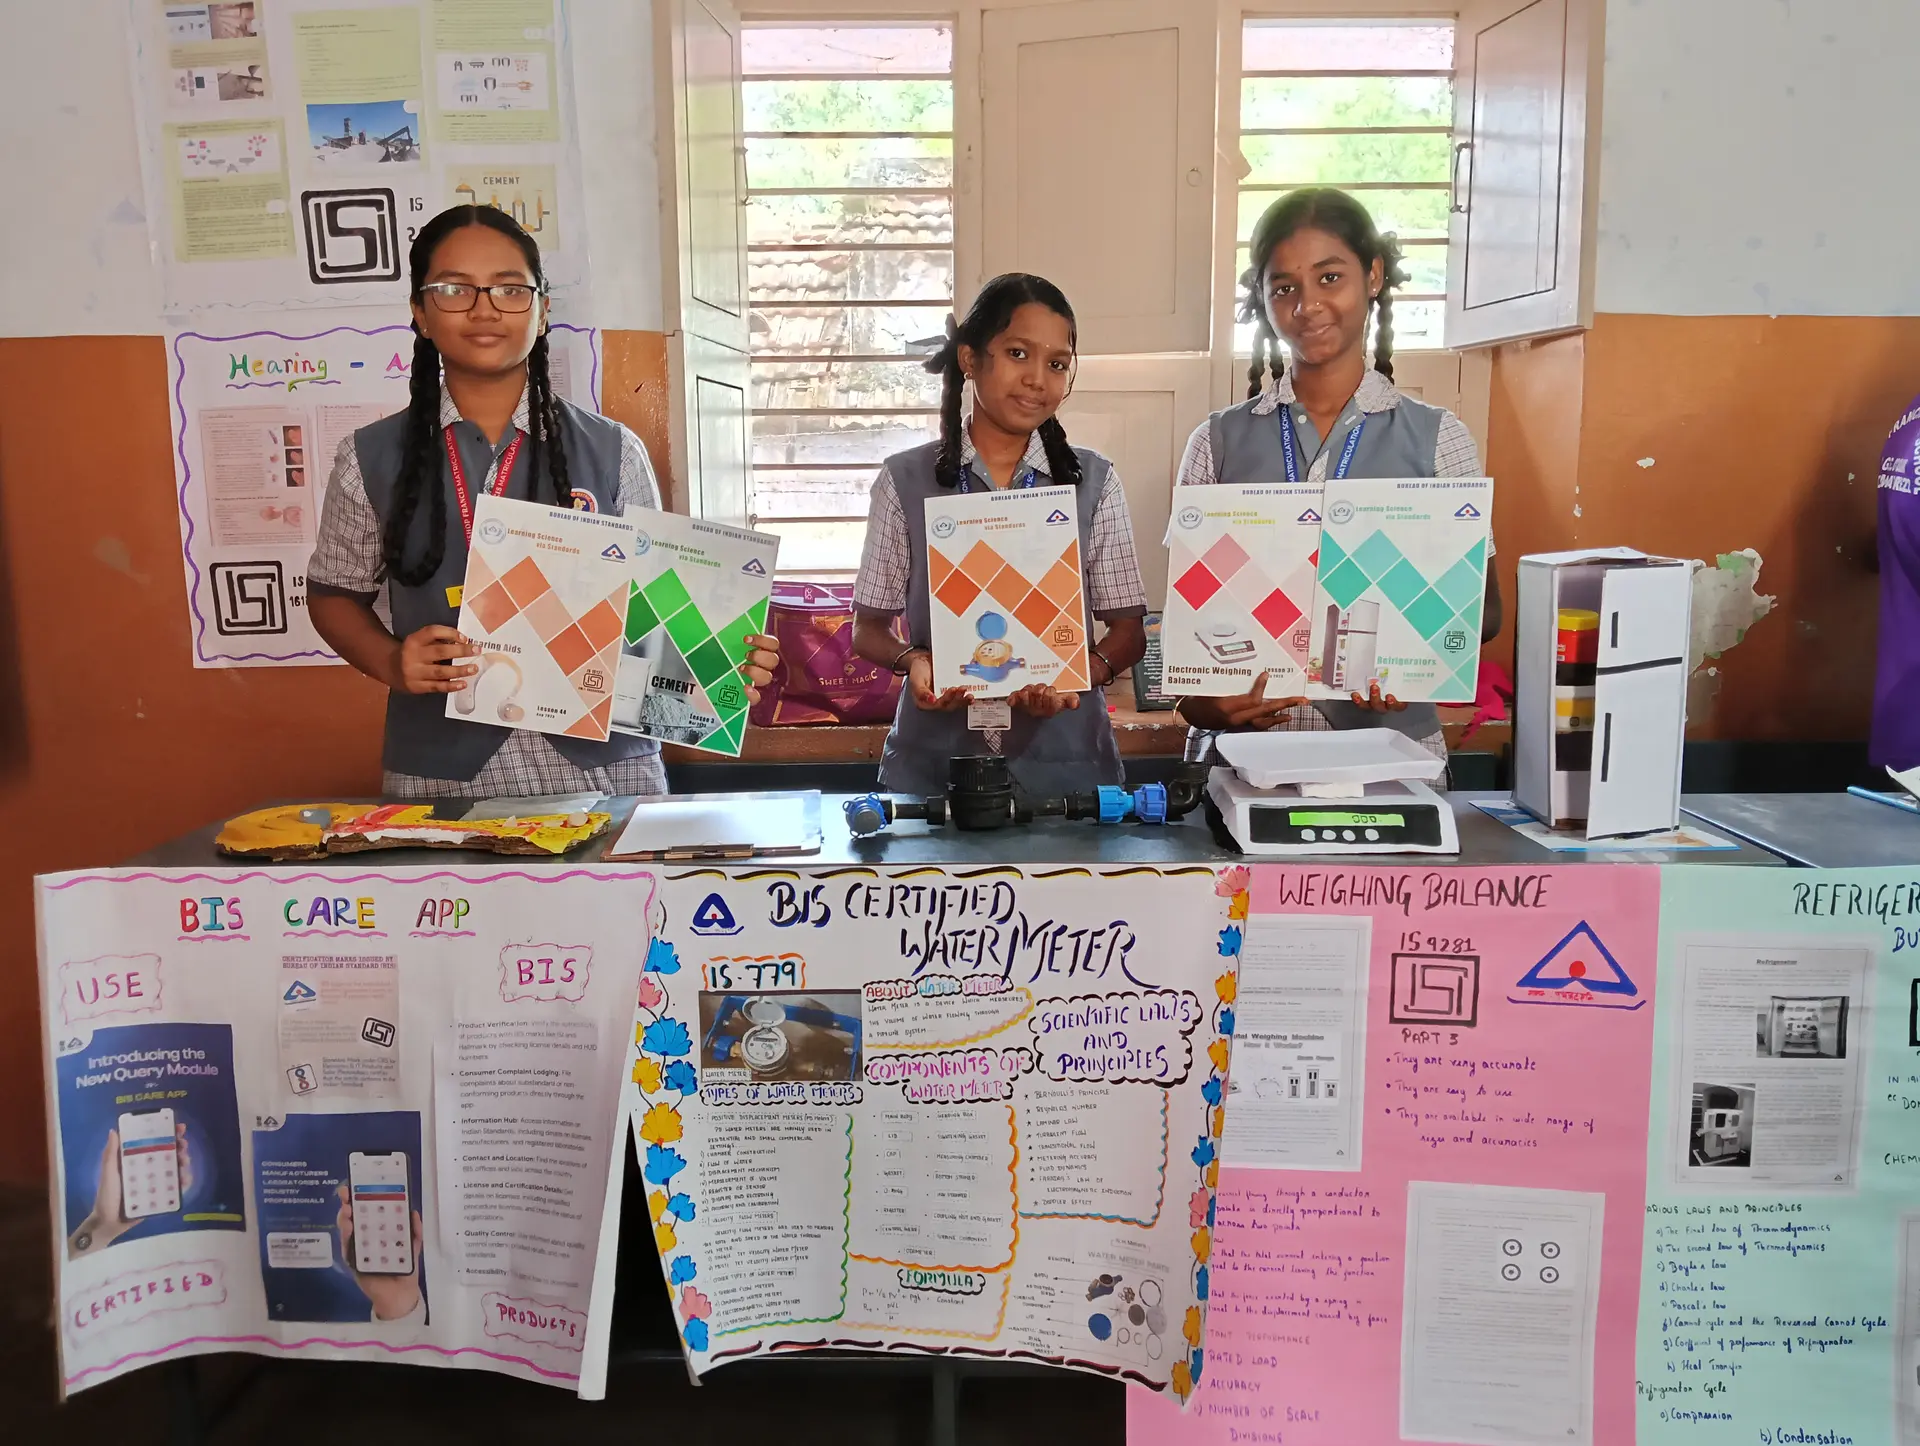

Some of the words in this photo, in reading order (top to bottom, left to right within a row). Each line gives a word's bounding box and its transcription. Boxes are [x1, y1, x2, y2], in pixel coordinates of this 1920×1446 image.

[483, 176, 520, 185] CEMENT
[409, 196, 423, 212] IS
[228, 352, 328, 383] Hearing
[386, 353, 410, 371] A
[457, 485, 470, 518] FRANCIS
[549, 512, 571, 520] BUREAU
[581, 517, 600, 525] INDIAN
[601, 521, 633, 531] STANDARDS
[508, 528, 535, 539] Learning
[537, 533, 563, 543] Science
[692, 524, 713, 533] BUREAU
[723, 531, 742, 540] INDIAN
[743, 535, 775, 546] STANDARDS
[548, 543, 580, 554] Standards
[652, 540, 678, 551] Learning
[680, 545, 704, 556] Science
[690, 556, 721, 568] Standards
[293, 576, 303, 587] IS
[503, 644, 522, 654] Aids
[1377, 656, 1436, 666] Refrigerators
[852, 669, 877, 683] MAGIC
[1168, 666, 1210, 674] Electronic
[1213, 668, 1252, 676] Weighing
[652, 676, 696, 695] CEMENT
[967, 684, 988, 692] Meter
[690, 713, 709, 723] Lesson
[1279, 874, 1411, 917] WEIGHING
[1422, 873, 1553, 909] BALANCE
[181, 897, 244, 932] BIS
[284, 897, 375, 929] CARE
[416, 897, 471, 929] APP
[767, 881, 831, 928] BIS
[844, 884, 1016, 932] CERTIFIED
[901, 923, 999, 976] WATER
[1005, 911, 1161, 988] METER
[1400, 932, 1421, 952] IS
[1427, 936, 1477, 953] 9281
[517, 959, 576, 985] BIS
[77, 972, 143, 1005] USE
[866, 986, 909, 997] ABOUT
[919, 978, 956, 994] WATER
[965, 977, 1001, 993] METER
[1042, 1005, 1129, 1033] SCIENTIFIC
[1140, 995, 1190, 1022] LAWS
[1084, 1032, 1128, 1050] AND
[1402, 1029, 1441, 1045] PART
[1449, 1033, 1459, 1046] 3
[88, 1050, 179, 1069] Introducing
[182, 1048, 205, 1060] the
[1057, 1045, 1168, 1078] PRINCIPLES
[869, 1056, 990, 1079] COMPONENTS
[1001, 1056, 1024, 1071] OF
[76, 1073, 111, 1088] New
[114, 1065, 164, 1081] Query
[167, 1064, 218, 1075] Module
[167, 1090, 187, 1098] APP
[705, 1089, 738, 1100] TYPES
[746, 1089, 760, 1100] OF
[768, 1087, 805, 1100] WATER
[812, 1088, 855, 1101] METERS
[911, 1083, 955, 1098] WATER
[961, 1080, 1003, 1097] METER
[1476, 1083, 1487, 1097] to
[1513, 1114, 1535, 1125] wide
[1584, 1118, 1595, 1134] of
[1453, 1134, 1474, 1145] and
[1372, 1206, 1380, 1217] to
[1686, 1205, 1712, 1215] LAWS
[1719, 1204, 1739, 1214] AND
[1744, 1203, 1803, 1214] PRINCIPLES
[1732, 1224, 1742, 1237] of
[1738, 1242, 1747, 1255] of
[1088, 1251, 1116, 1261] WATER
[1119, 1255, 1146, 1267] METER
[1712, 1259, 1727, 1269] law
[907, 1273, 973, 1287] FORMULA
[1710, 1282, 1725, 1291] law
[74, 1272, 213, 1328] CERTIFIED
[1712, 1302, 1727, 1310] law
[496, 1303, 576, 1337] PRODUCTS
[1730, 1316, 1743, 1327] and
[1209, 1350, 1242, 1366] RATED
[1252, 1355, 1278, 1368] LOAD
[1682, 1359, 1702, 1371] Heat
[1210, 1378, 1261, 1392] ACCURACY
[1704, 1380, 1727, 1399] Cycle
[1209, 1403, 1250, 1417] NUMBER
[1261, 1408, 1274, 1418] OF
[1286, 1407, 1319, 1423] SCALE
[1230, 1427, 1283, 1443] DIVISIONS
[1777, 1427, 1853, 1445] Condensation
